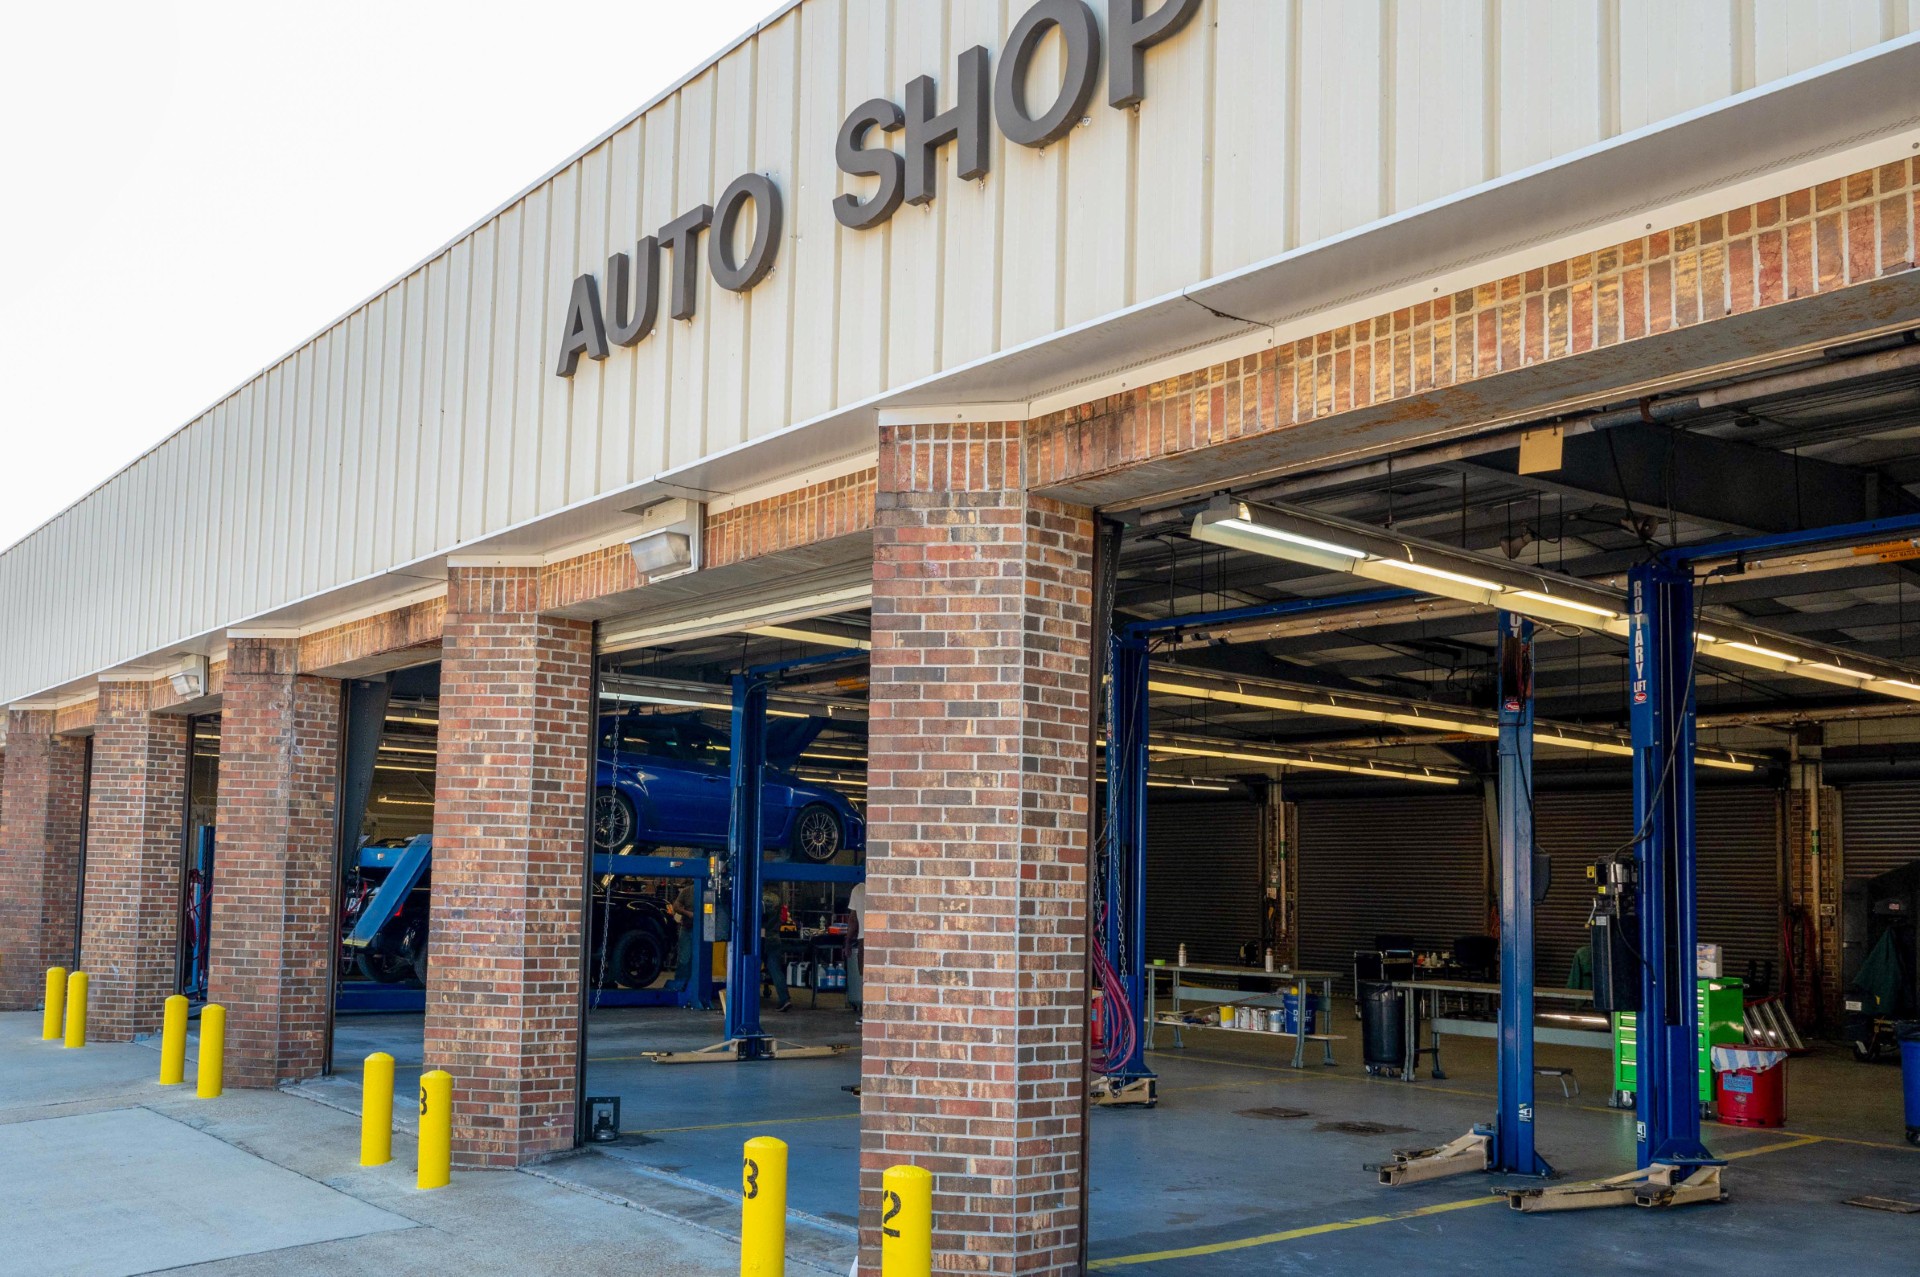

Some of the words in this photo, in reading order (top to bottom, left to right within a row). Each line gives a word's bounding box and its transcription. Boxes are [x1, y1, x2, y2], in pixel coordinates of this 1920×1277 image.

[556, 172, 783, 377] AUTO
[832, 0, 1200, 230] SHOP
[1633, 580, 1644, 680] ROTARY
[1634, 680, 1647, 693] LIFT
[743, 1158, 758, 1199] 3
[884, 1190, 901, 1237] 2
